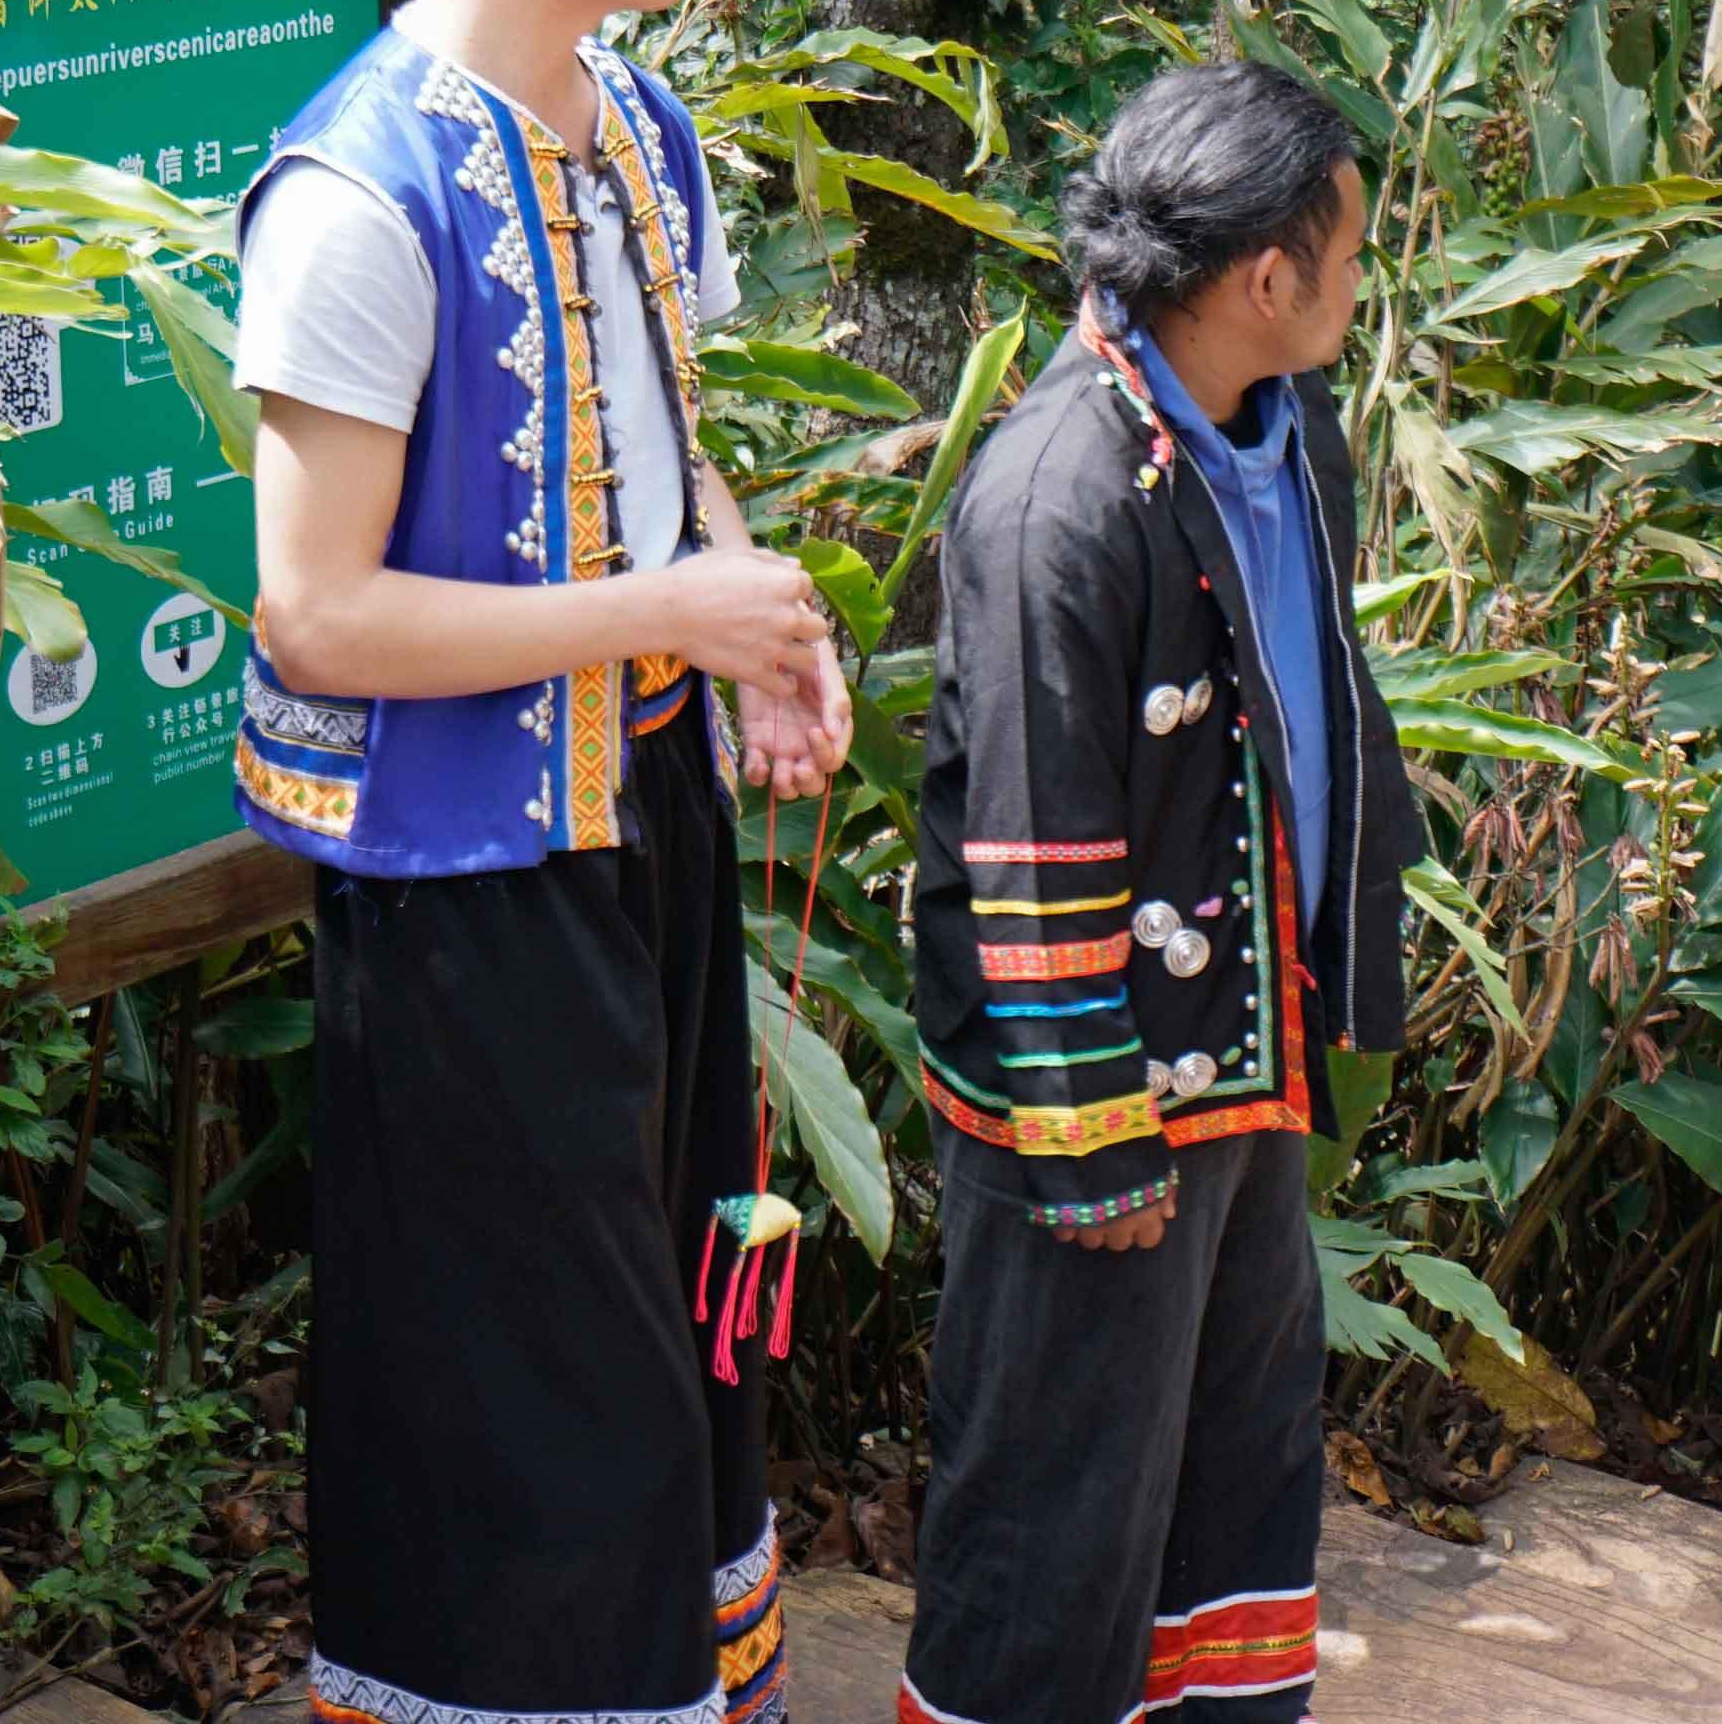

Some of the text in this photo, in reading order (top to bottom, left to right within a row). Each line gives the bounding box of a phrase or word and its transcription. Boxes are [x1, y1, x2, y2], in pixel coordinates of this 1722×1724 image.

[125, 513, 174, 539] Guide
[27, 544, 68, 565] Scan
[168, 616, 203, 645] 关注
[147, 714, 156, 729] 3
[163, 711, 223, 746] 行公众号
[184, 739, 207, 757] view
[24, 755, 34, 771] 2
[187, 750, 226, 772] number
